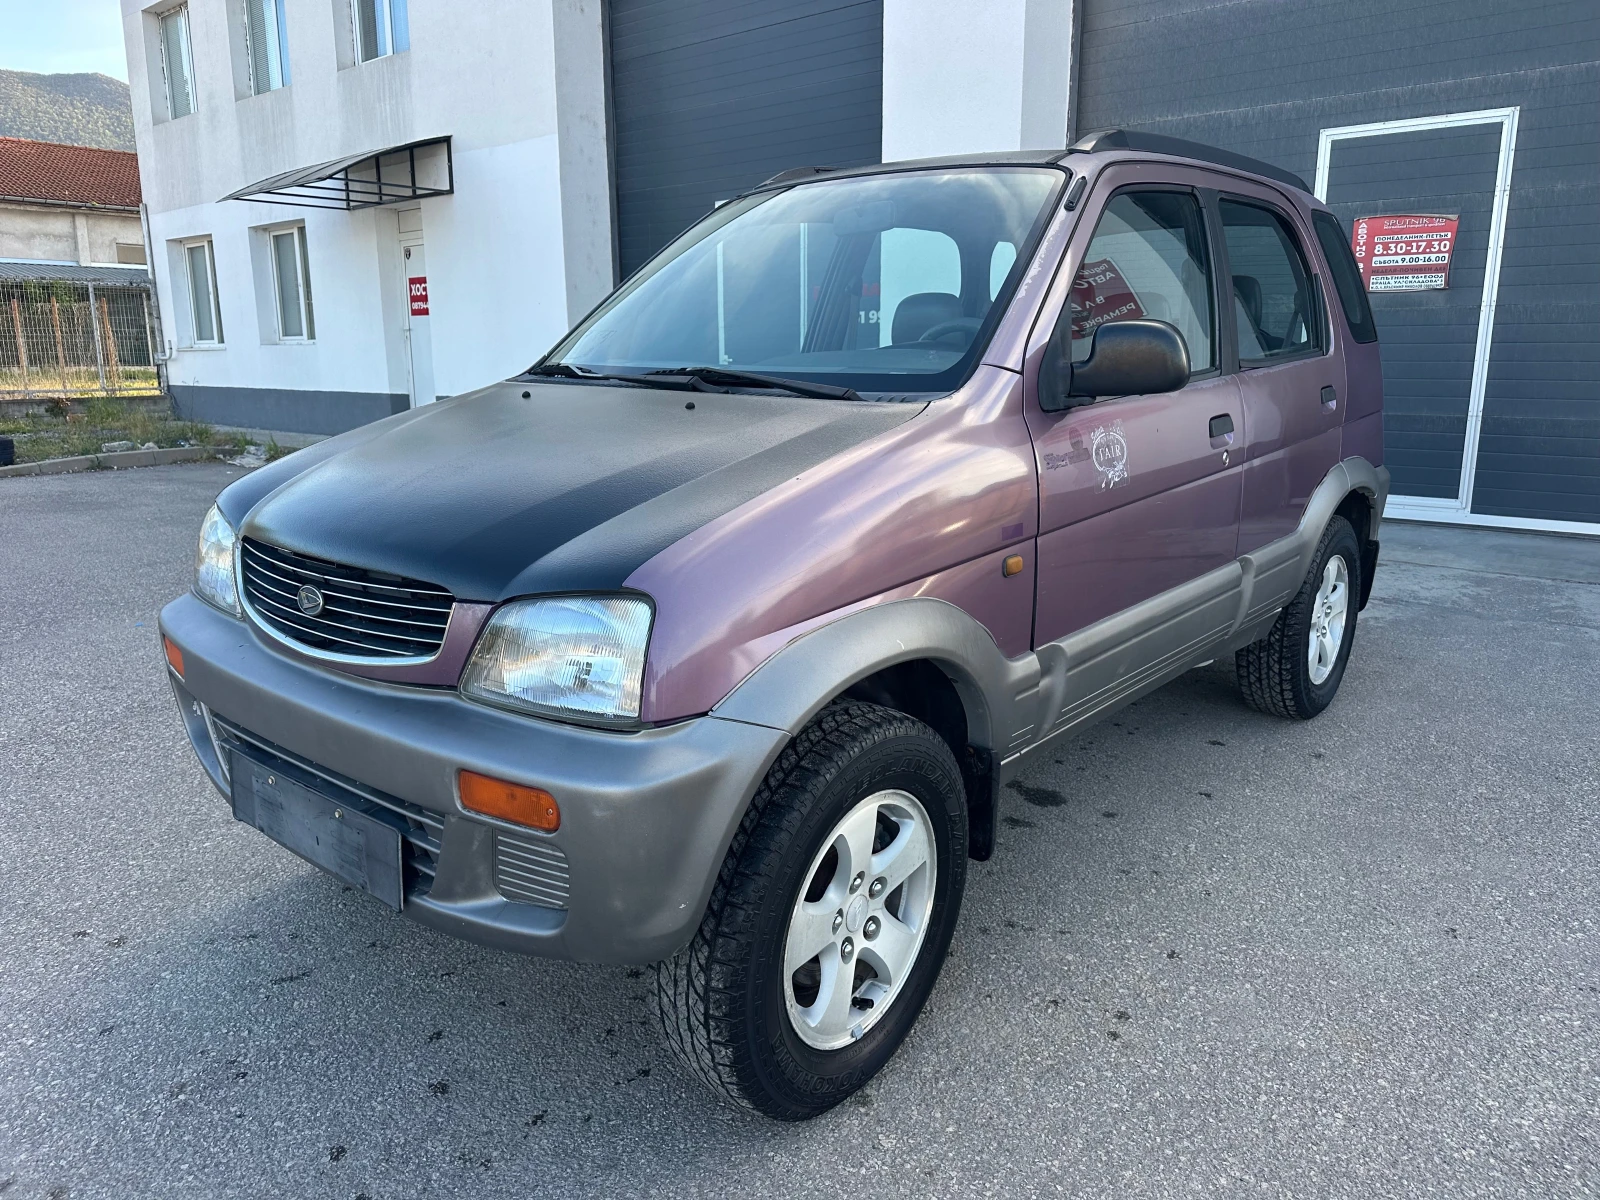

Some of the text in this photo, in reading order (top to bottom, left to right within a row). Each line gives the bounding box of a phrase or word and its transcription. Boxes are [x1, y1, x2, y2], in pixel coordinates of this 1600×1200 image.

[1374, 241, 1450, 254] 8.30-17.30
[1400, 255, 1446, 264] 9.00-16.00
[410, 283, 428, 296] ХОС
[842, 756, 955, 808] GEOLANDAR
[771, 1030, 867, 1095] YOKOHAMA
